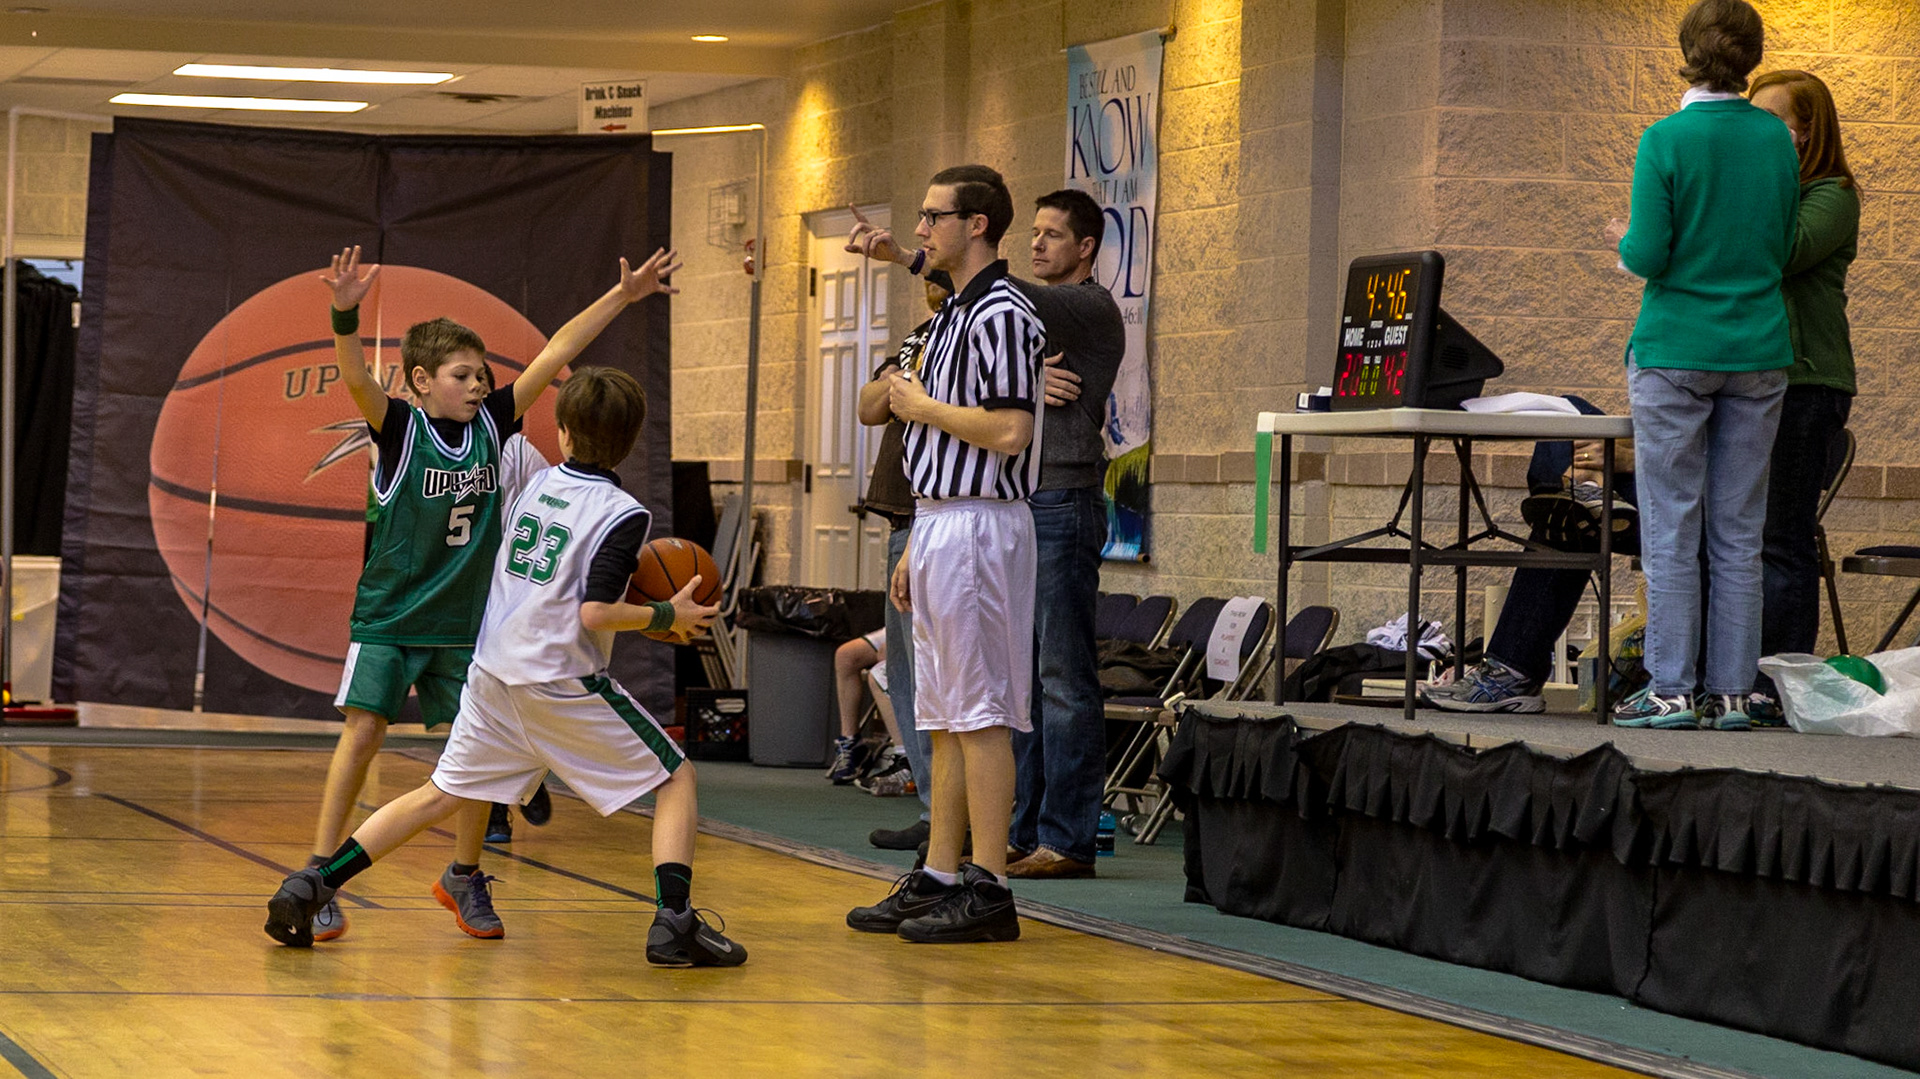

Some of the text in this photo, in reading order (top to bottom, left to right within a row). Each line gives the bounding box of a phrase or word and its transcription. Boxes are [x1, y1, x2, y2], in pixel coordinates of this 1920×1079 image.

[1111, 65, 1136, 94] AND
[1069, 92, 1152, 179] KNOW
[1093, 206, 1149, 298] OD
[1366, 269, 1411, 320] 4:46
[1343, 325, 1409, 348] HOME GUEST
[445, 504, 476, 547] 5
[505, 511, 573, 586] 23
